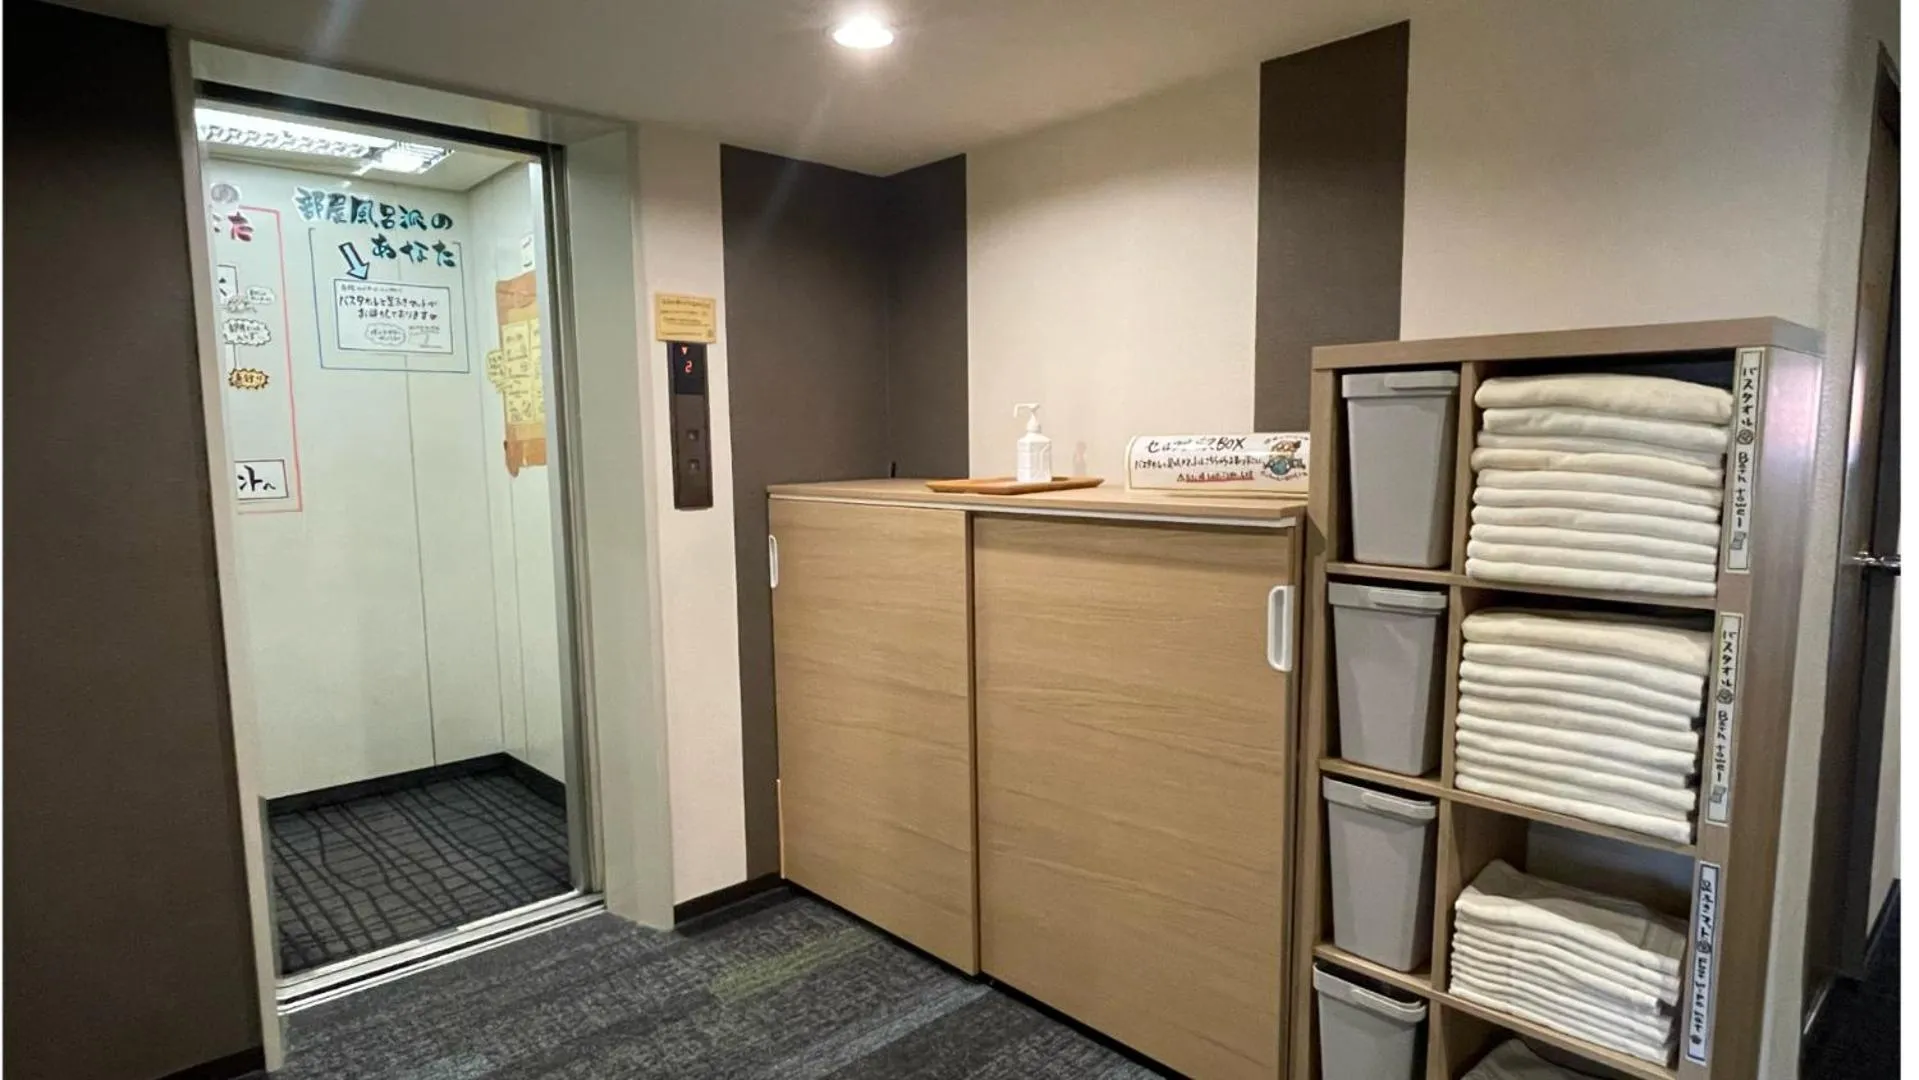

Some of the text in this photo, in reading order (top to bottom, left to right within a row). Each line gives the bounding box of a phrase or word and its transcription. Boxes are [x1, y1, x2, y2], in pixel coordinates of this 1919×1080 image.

[295, 187, 453, 231] 部屋風呂派の
[371, 233, 456, 267] あなた
[684, 360, 693, 374] 2
[1741, 367, 1757, 427] バスタオル
[1735, 452, 1749, 528] Bath towel
[1722, 631, 1737, 688] バスタオル
[1715, 710, 1729, 783] Bath towel
